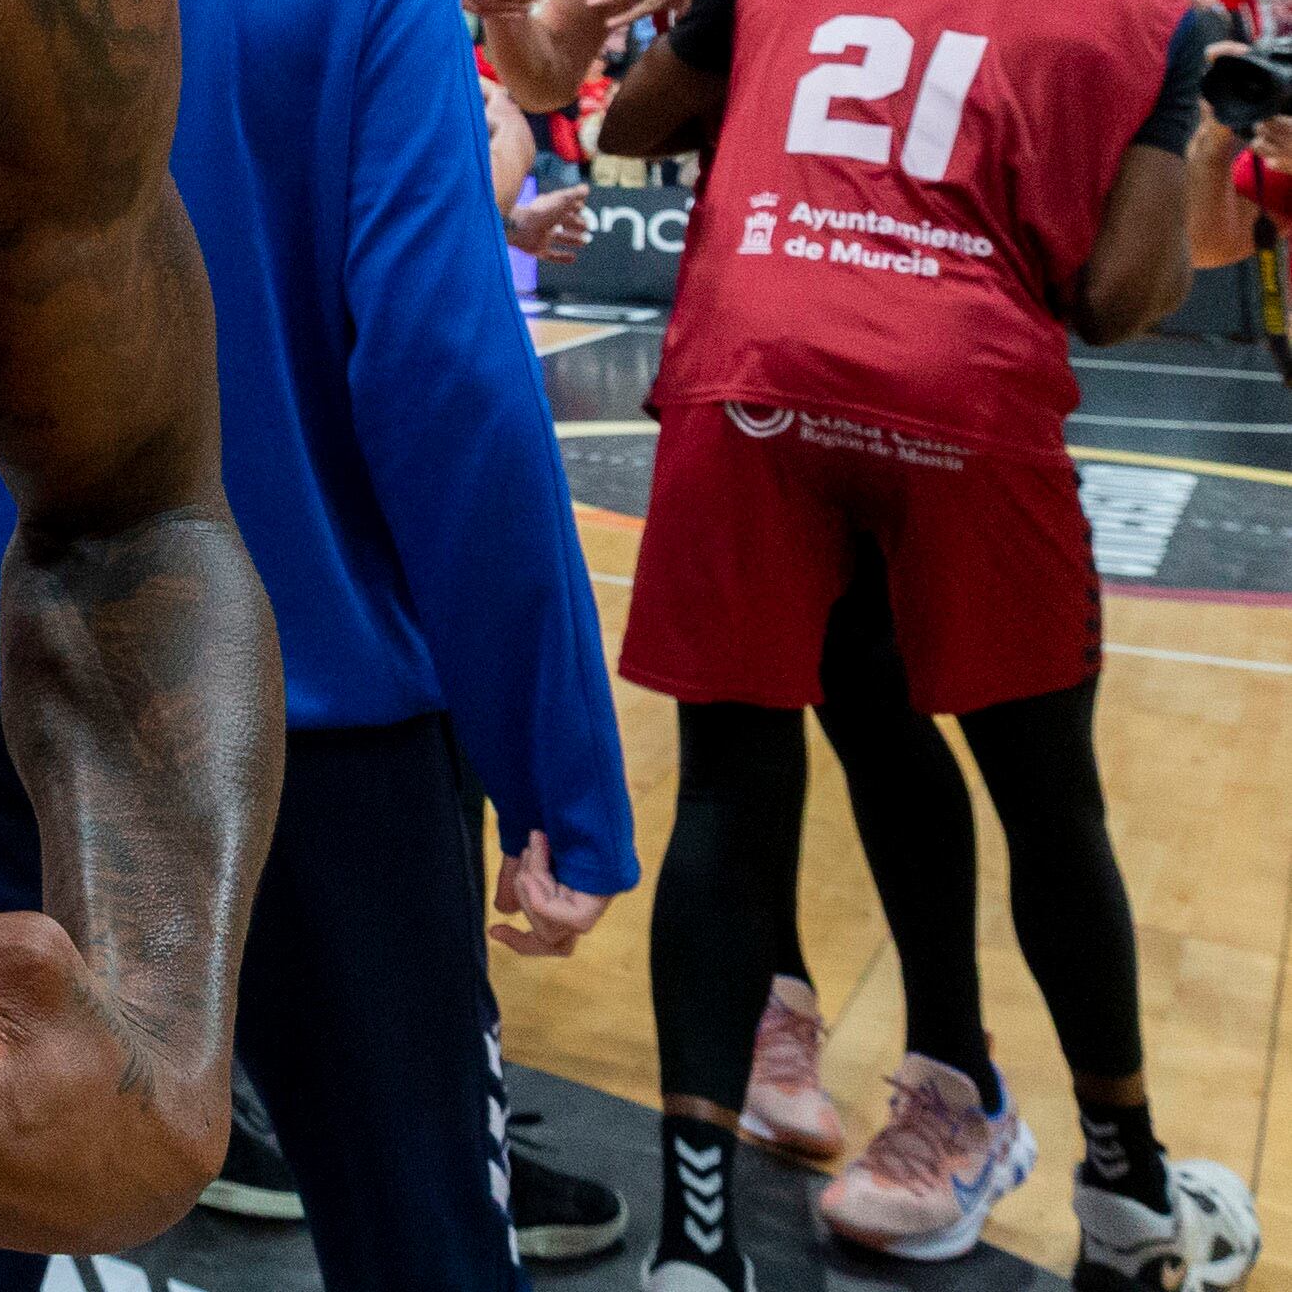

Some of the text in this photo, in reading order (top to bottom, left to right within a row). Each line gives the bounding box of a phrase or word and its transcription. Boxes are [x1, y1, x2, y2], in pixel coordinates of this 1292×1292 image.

[785, 14, 988, 182] 21
[784, 235, 939, 278] de Murcia
[789, 201, 994, 258] Ayuntamiento
